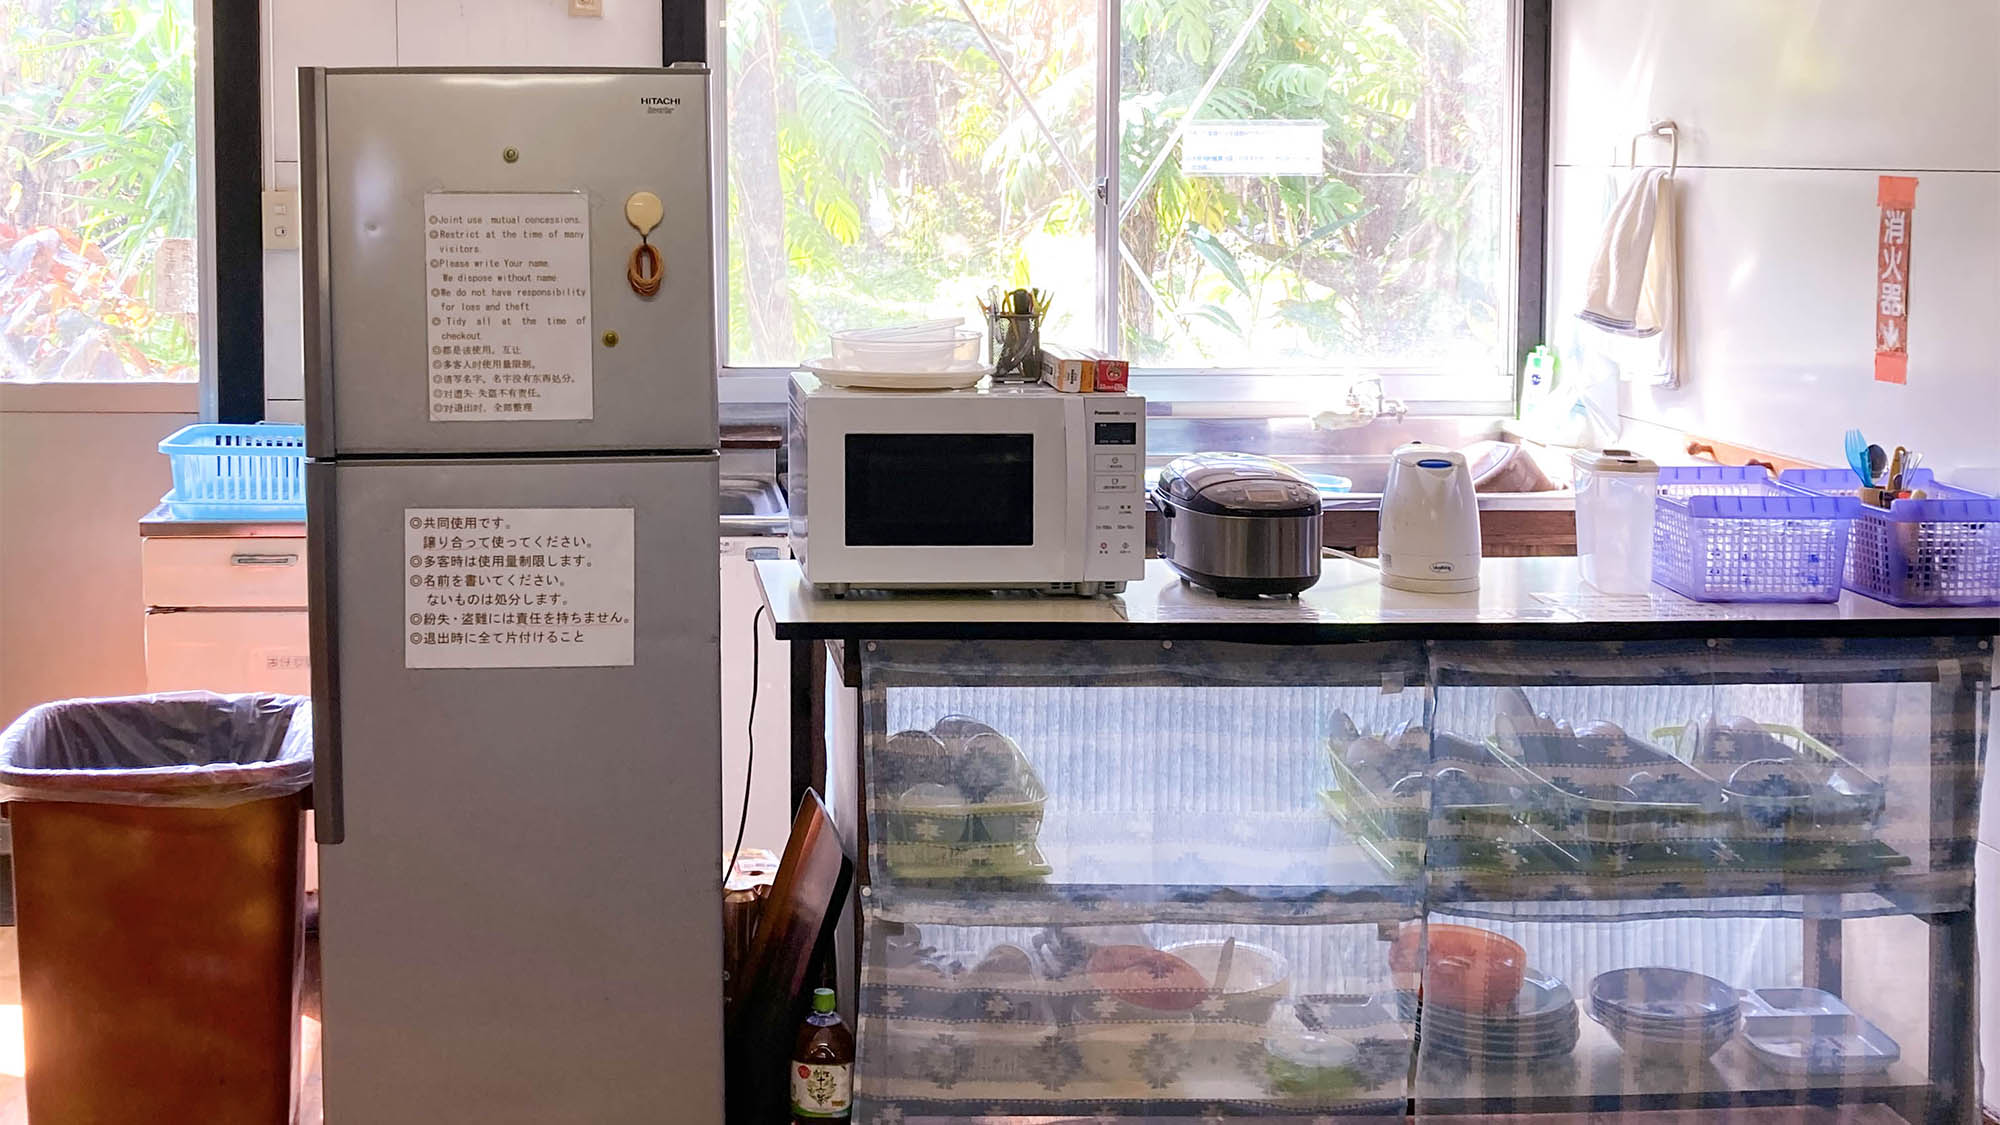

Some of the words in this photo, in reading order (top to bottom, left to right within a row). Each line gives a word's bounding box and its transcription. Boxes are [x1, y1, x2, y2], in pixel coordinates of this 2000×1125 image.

[640, 97, 681, 105] HITACHI
[490, 215, 521, 225] mutual
[439, 229, 480, 240] Restrict
[485, 229, 497, 240] at
[502, 229, 517, 240] the
[523, 229, 543, 240] time
[548, 229, 558, 240] of
[564, 229, 585, 240] many
[439, 258, 470, 268] Please
[474, 258, 500, 268] write
[504, 258, 523, 268] Your
[1881, 209, 1906, 317] 消火器
[443, 273, 453, 284] We
[457, 273, 493, 284] dispose
[497, 273, 532, 284] without
[456, 288, 467, 299] do
[471, 288, 486, 299] not
[492, 288, 512, 299] have
[517, 288, 587, 299] responsibility
[441, 303, 455, 312] for
[462, 303, 481, 312] loss
[485, 303, 501, 312] and
[446, 316, 467, 327] Tidy
[476, 316, 491, 327] all
[502, 316, 512, 327] at
[522, 316, 537, 327] the
[547, 316, 567, 327] time
[576, 316, 587, 327] of
[426, 593, 569, 607] ないものは処分します。
